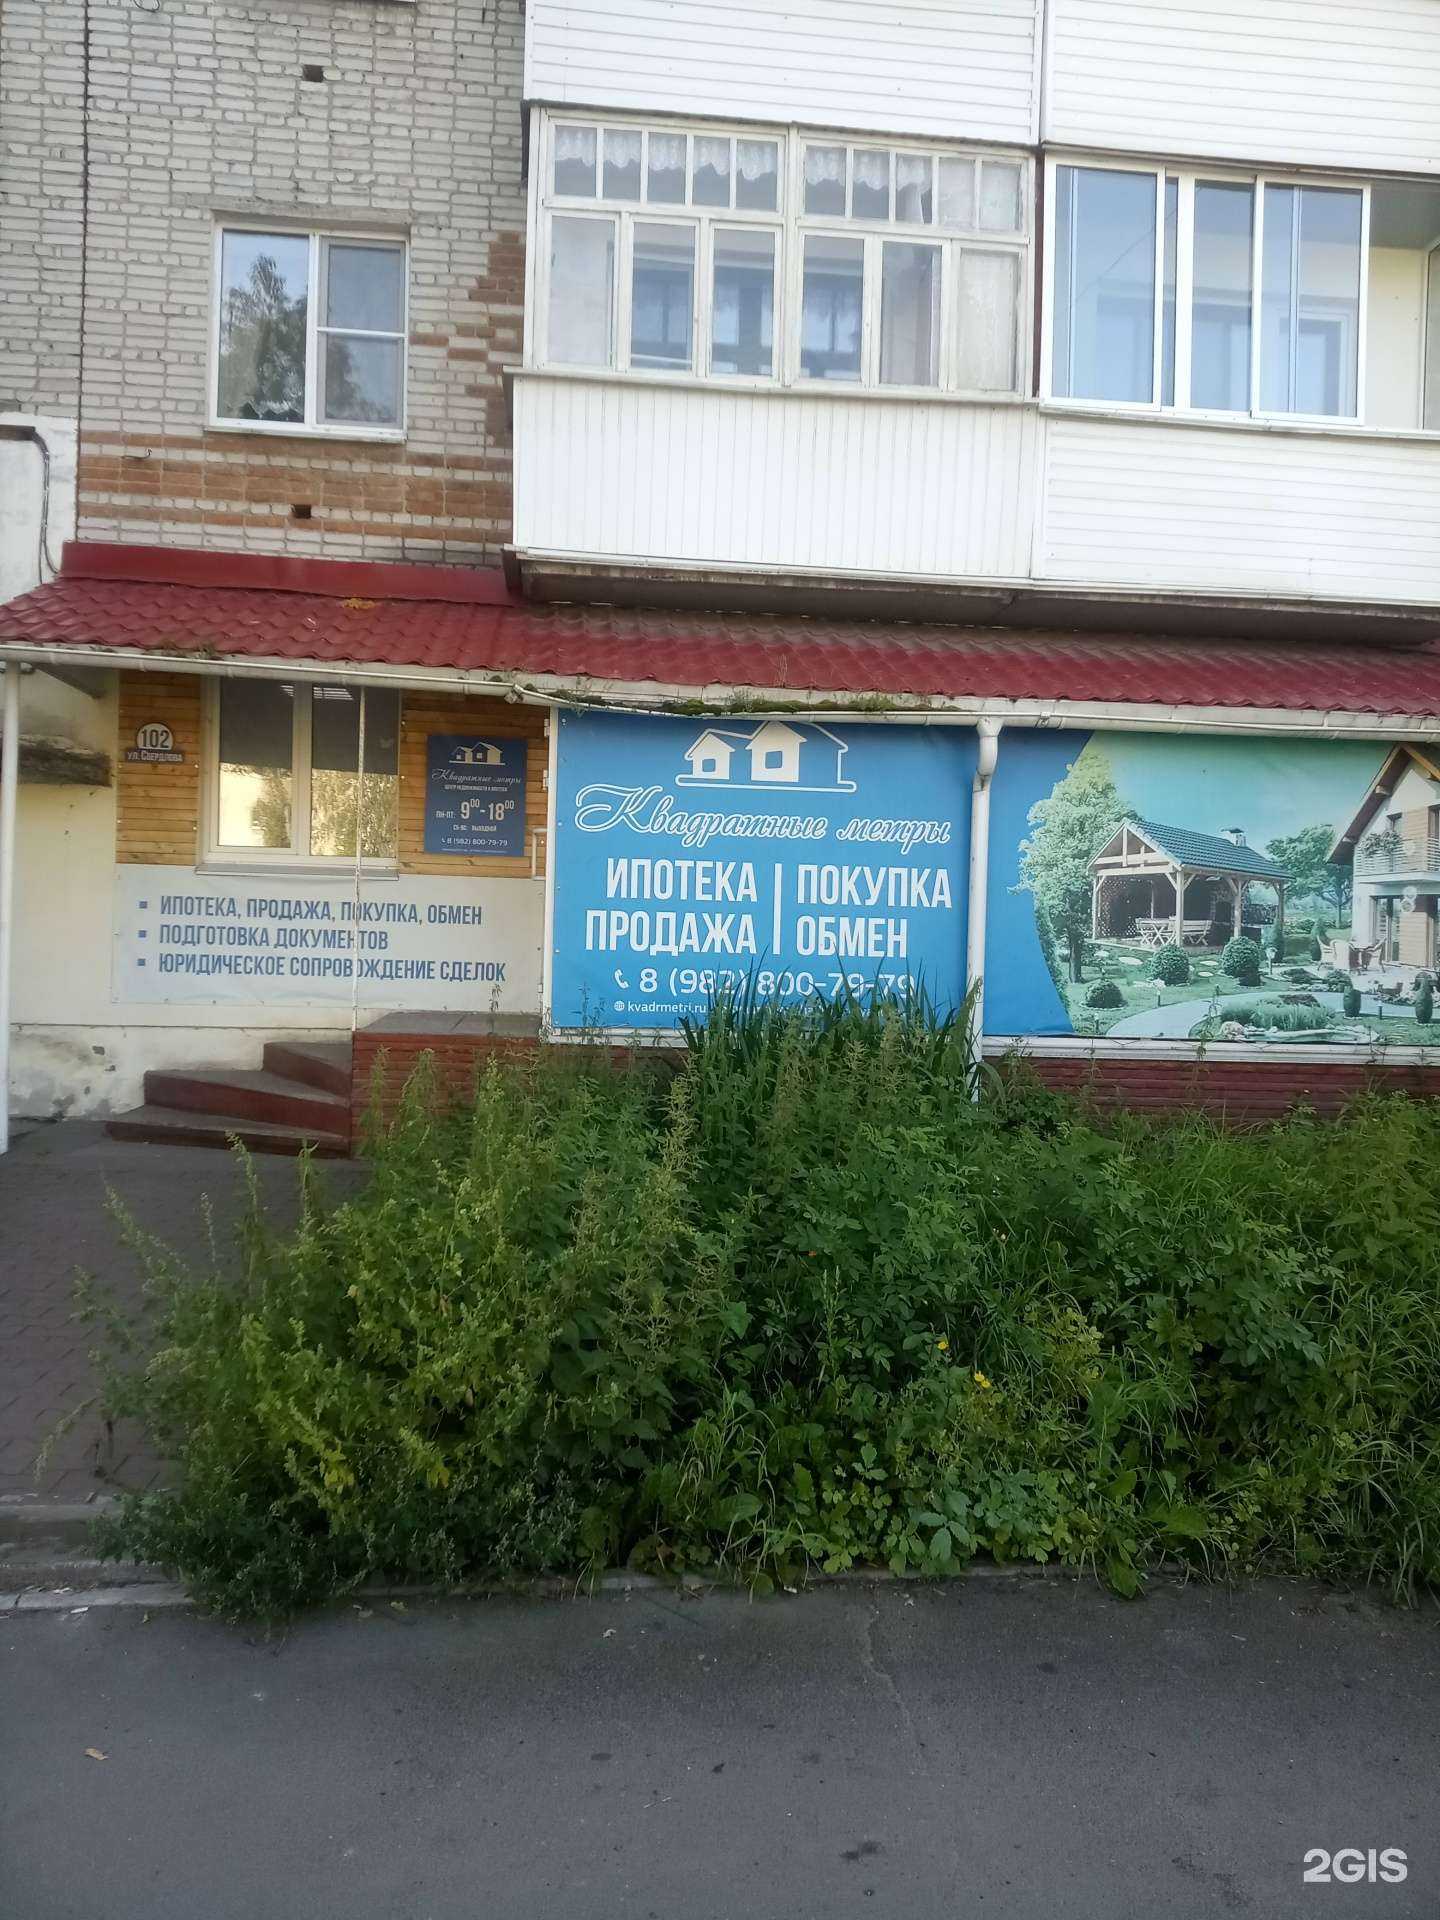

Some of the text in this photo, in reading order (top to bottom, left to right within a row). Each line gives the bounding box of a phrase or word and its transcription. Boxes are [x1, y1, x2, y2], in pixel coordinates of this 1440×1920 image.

[141, 729, 170, 748] 102
[574, 783, 951, 855] Квадратные метры
[606, 857, 953, 909] ИПОТЕКА ПОКУПКА
[160, 895, 482, 925] ИПОТЕКА, ПРОДАЖА, ПОКУПКА, ОБМЕН
[159, 924, 388, 950] ПОДГОТОВКА ДОКУМЕНТОВ
[585, 909, 908, 958] ПРОДАЖА ОБМЕН
[159, 952, 286, 976] ЮРИДИЧЕСКОЕ
[440, 961, 506, 982] СДЕЛОК
[639, 968, 658, 993] 8
[757, 970, 915, 999] 800-79-79
[627, 1000, 707, 1013] kvadrmetri.ru
